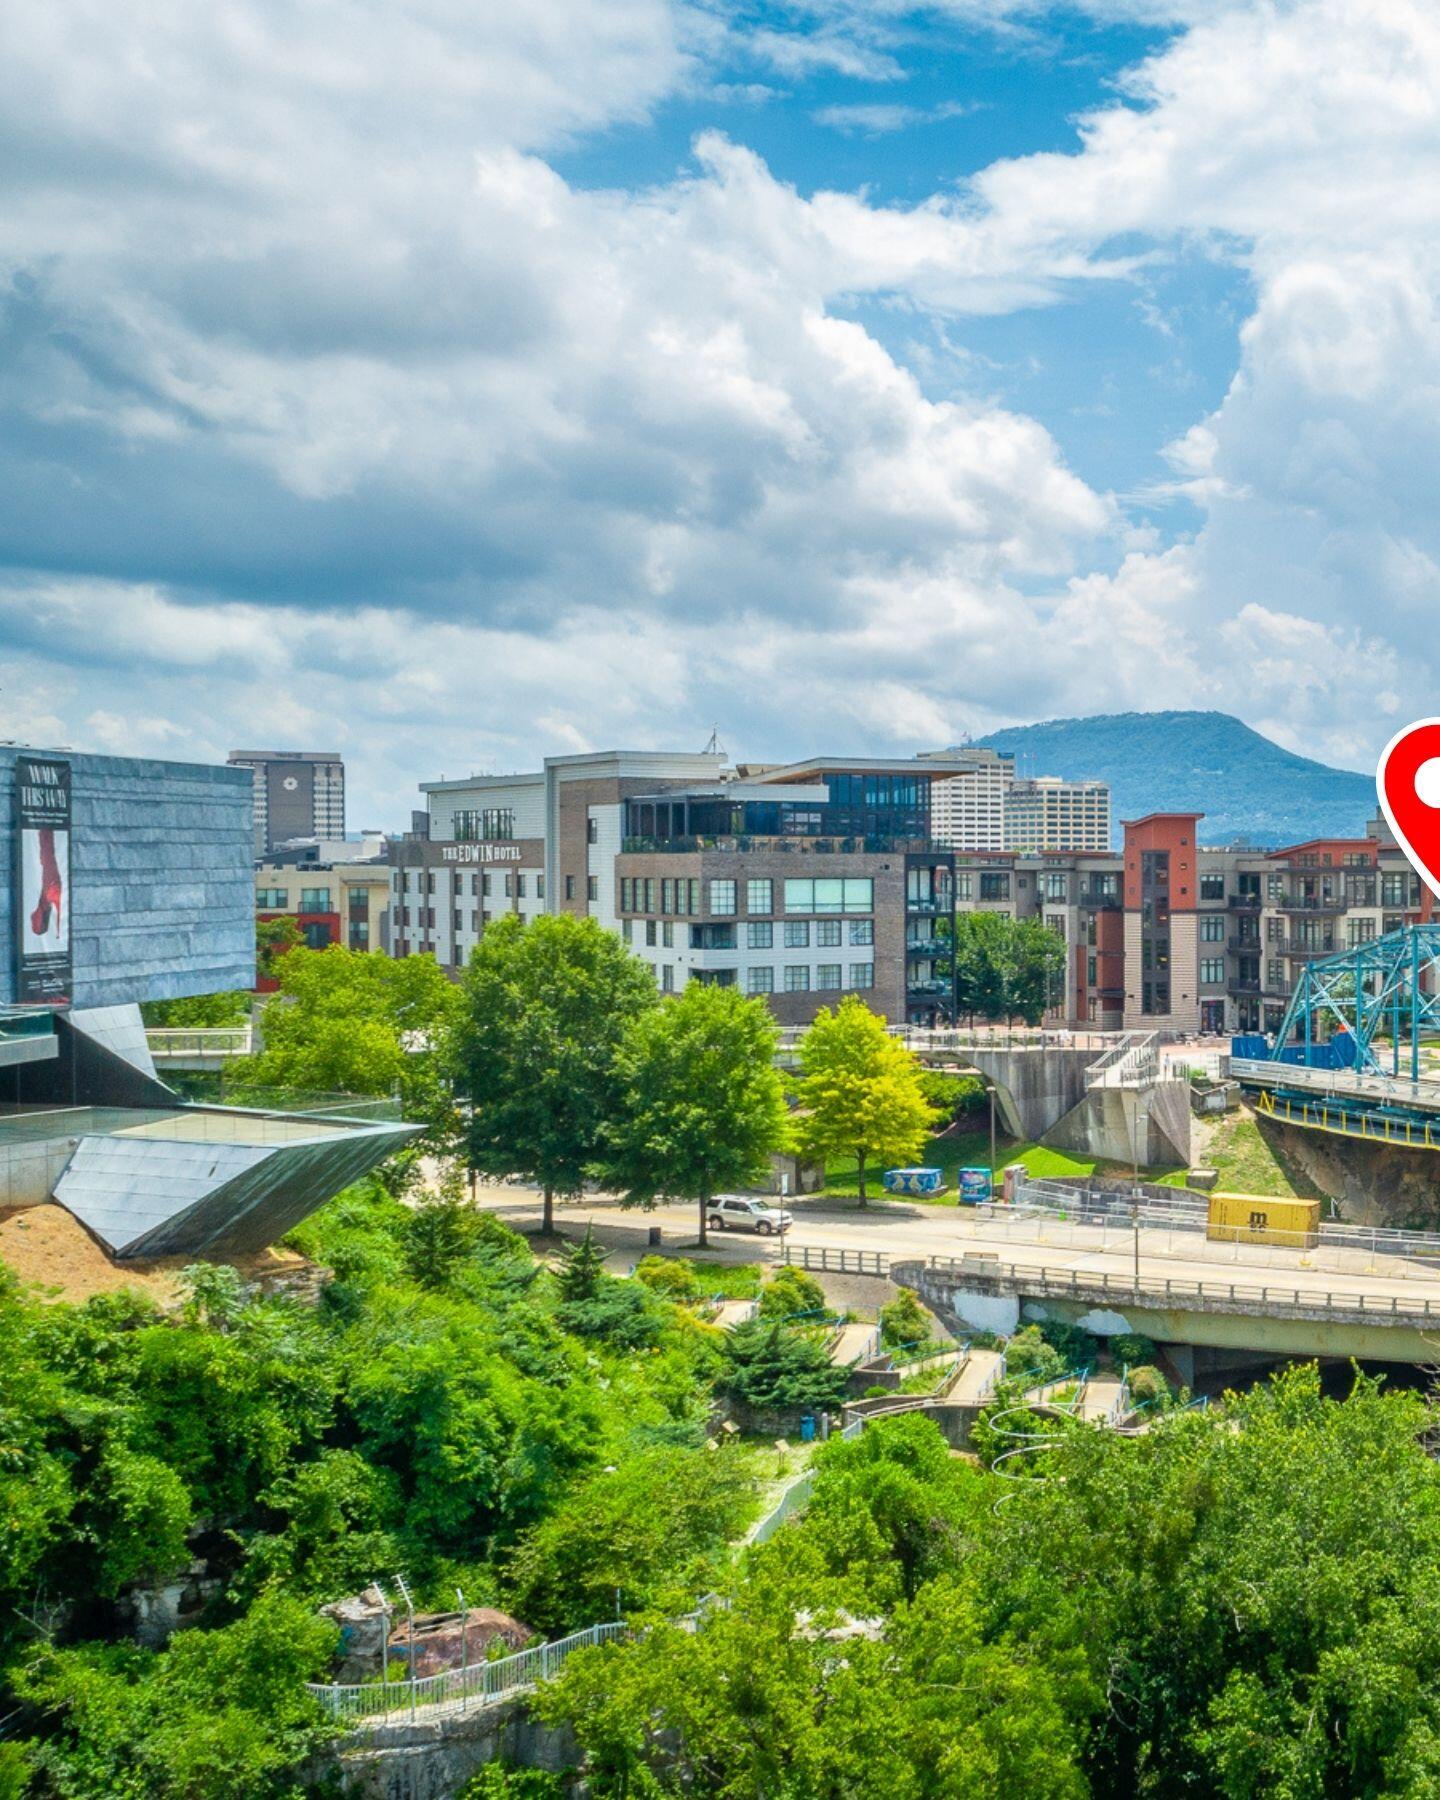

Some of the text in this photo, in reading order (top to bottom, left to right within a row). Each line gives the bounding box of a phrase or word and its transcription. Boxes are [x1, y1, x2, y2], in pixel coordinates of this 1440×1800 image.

[442, 844, 522, 862] THE EDWIN HOTEL
